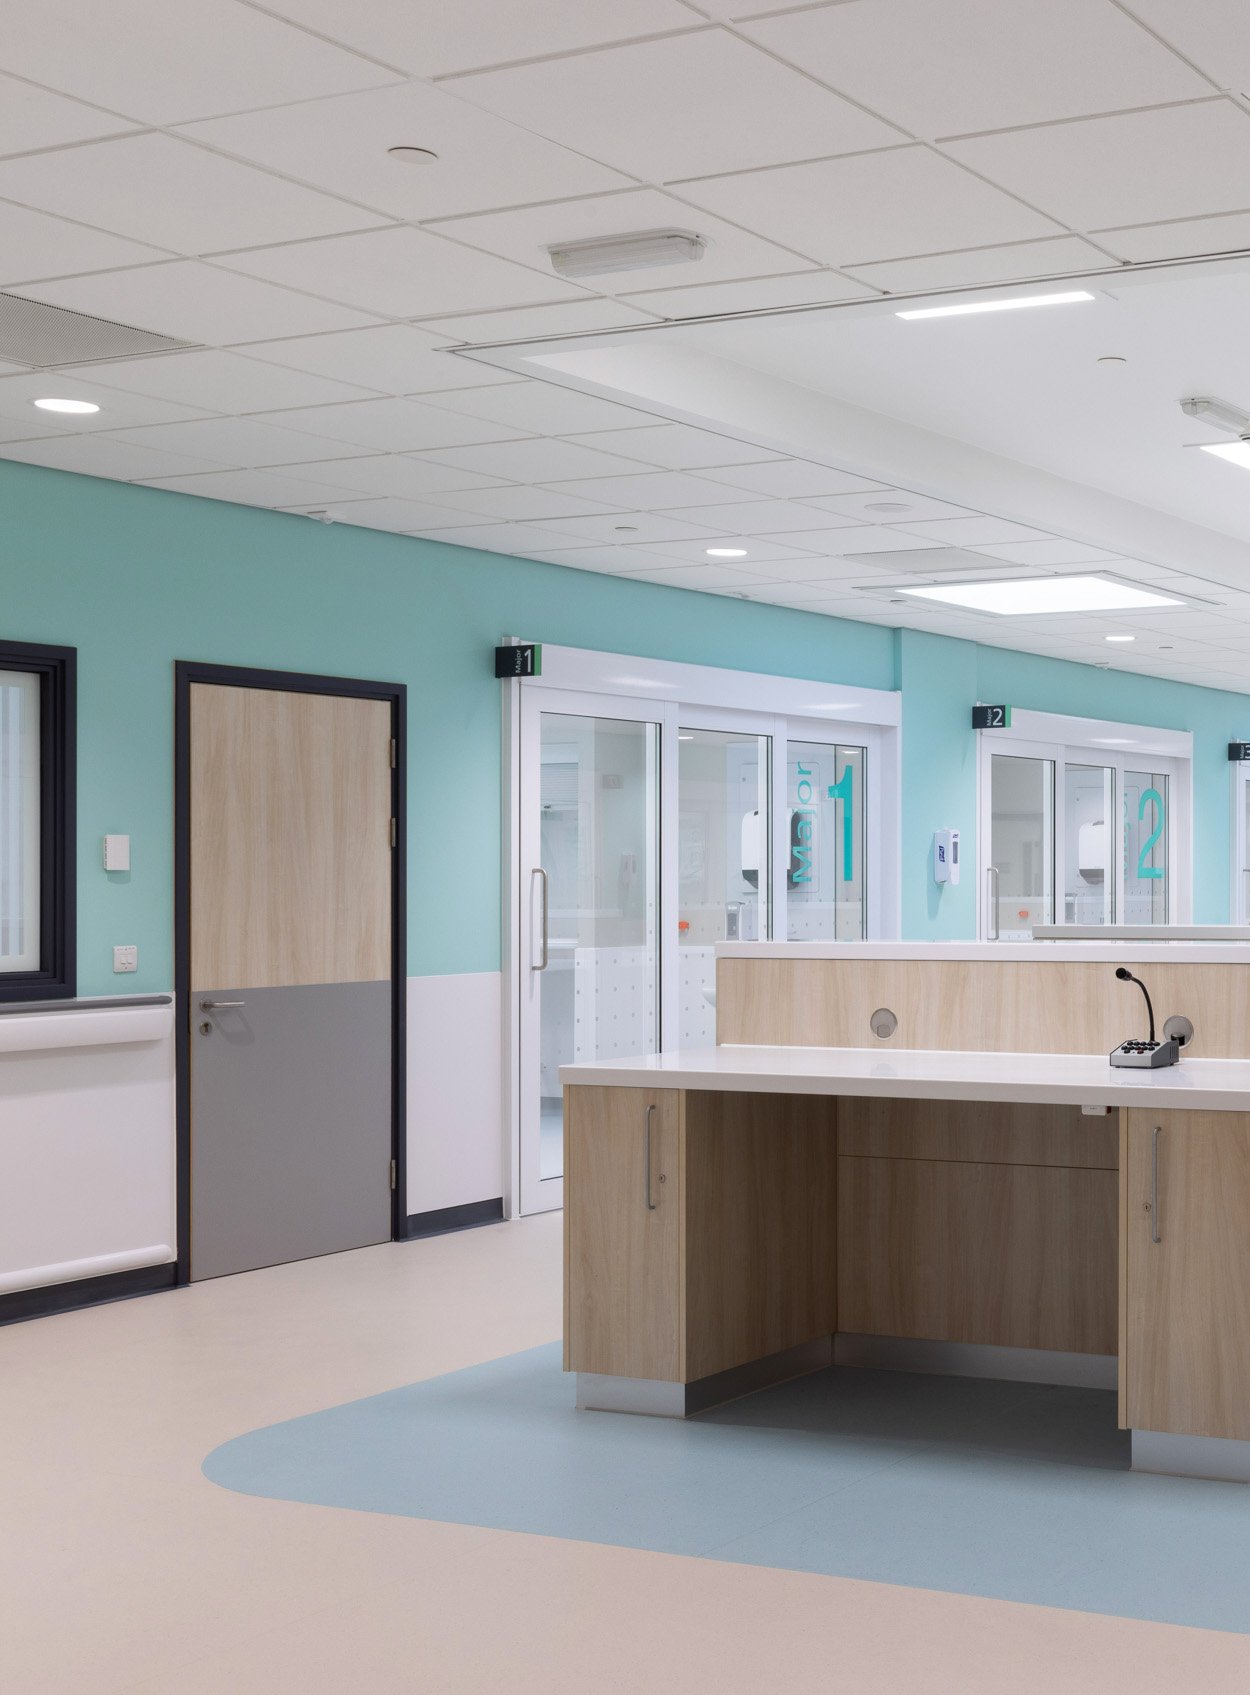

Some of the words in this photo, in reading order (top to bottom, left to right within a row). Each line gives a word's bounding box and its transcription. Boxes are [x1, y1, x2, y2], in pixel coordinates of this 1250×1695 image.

[524, 648, 532, 673] 1
[992, 708, 1003, 726] 2
[792, 761, 816, 883] Major
[827, 765, 853, 881] 1
[1137, 788, 1165, 879] 2
